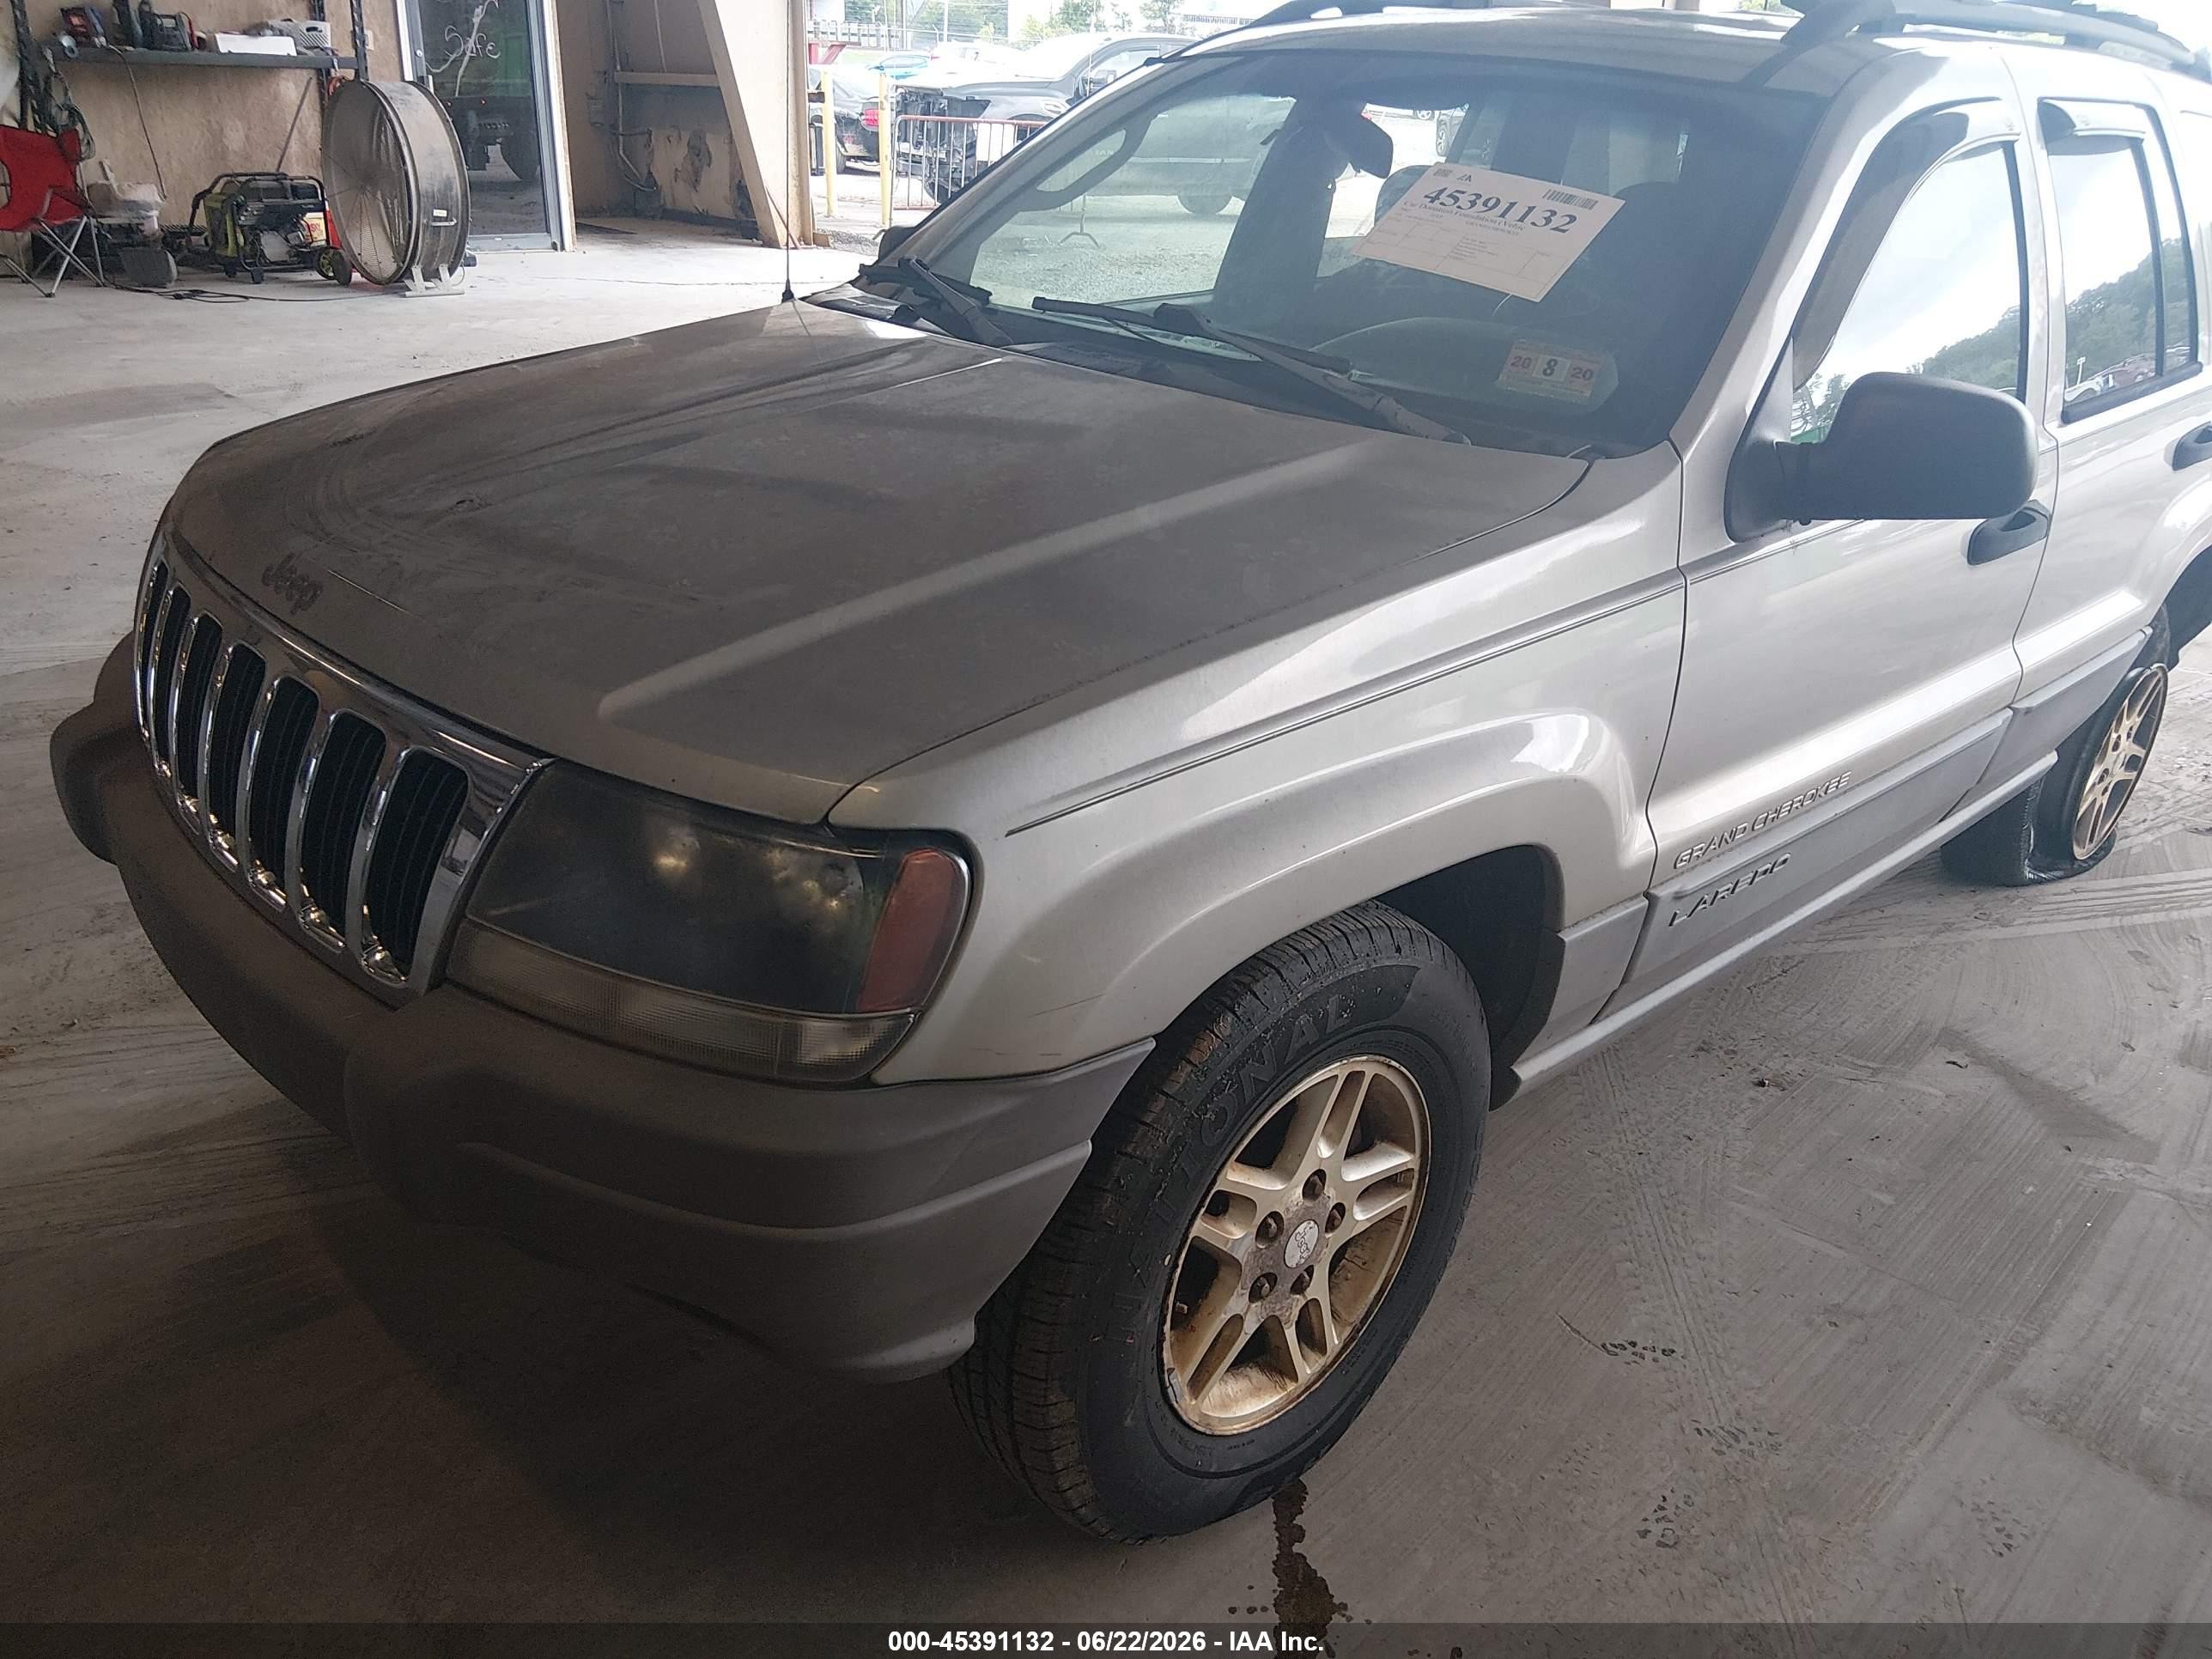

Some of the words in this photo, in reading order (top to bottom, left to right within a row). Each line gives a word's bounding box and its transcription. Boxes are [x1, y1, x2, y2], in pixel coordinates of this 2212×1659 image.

[1423, 186, 1578, 234] 45391132
[1510, 356, 1532, 369] 20
[1542, 357, 1559, 377] 8
[1571, 367, 1594, 381] 20
[1674, 823, 1749, 869] GRAND
[1751, 771, 1852, 832] CHEROKEE
[1668, 853, 1791, 927] LAREDO
[1295, 1230, 1310, 1261] Jeep
